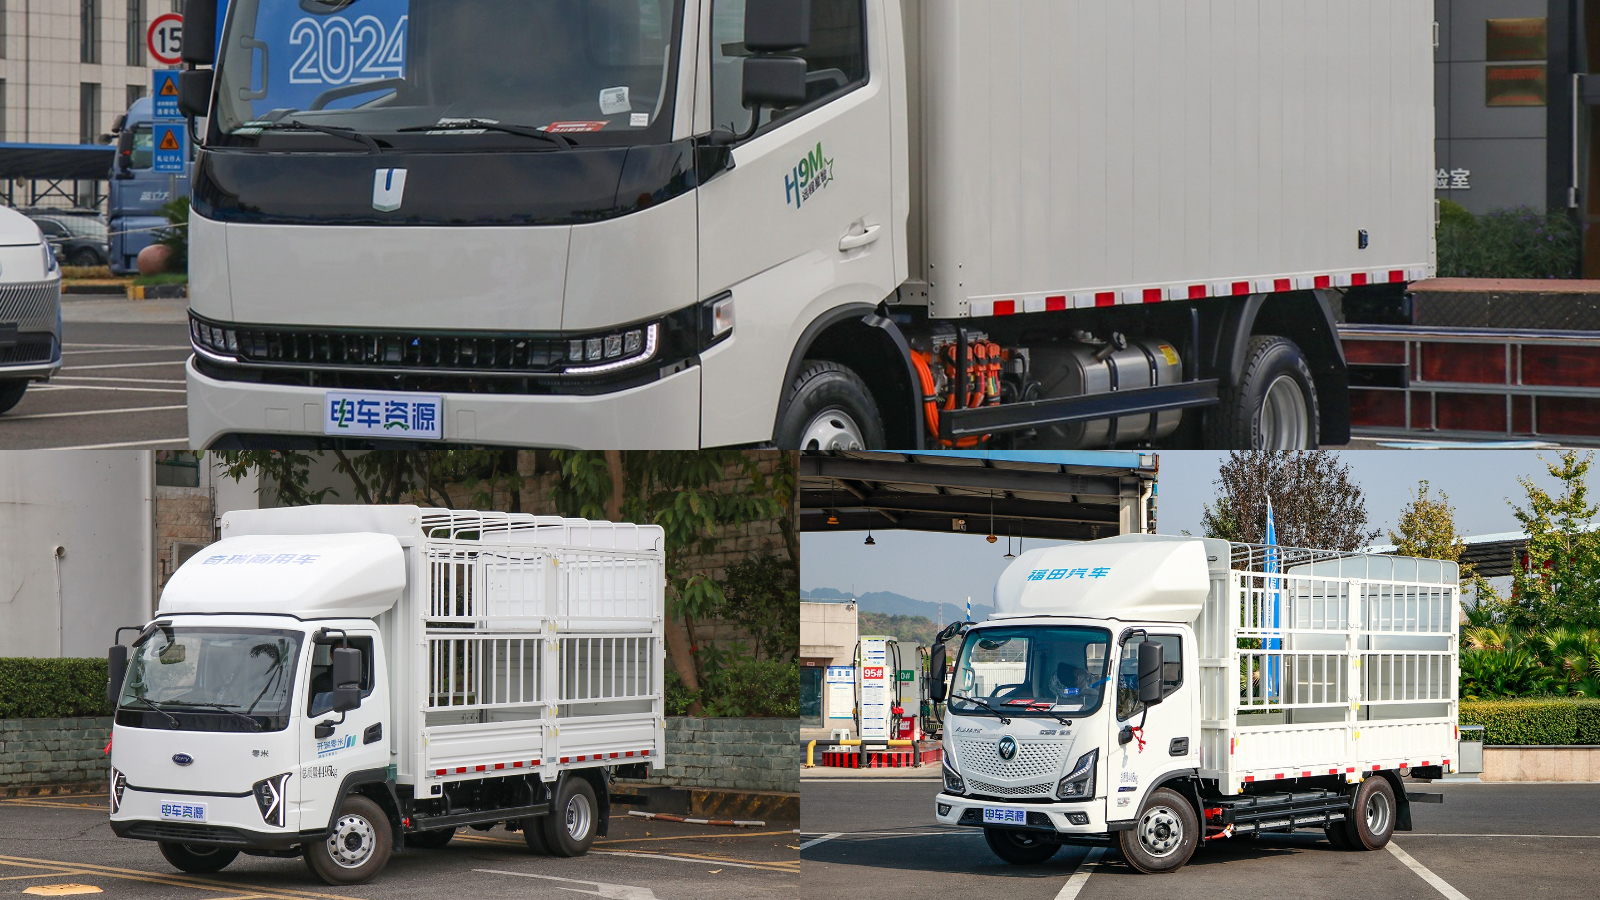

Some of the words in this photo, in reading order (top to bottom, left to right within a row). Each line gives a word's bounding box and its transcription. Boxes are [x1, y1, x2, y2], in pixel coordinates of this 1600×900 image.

[158, 27, 182, 53] 15
[289, 15, 408, 84] 2024
[784, 141, 823, 209] H9M
[331, 398, 436, 431] 电车资源
[202, 553, 321, 566] 奇瑞商用车
[1027, 567, 1111, 581] 福田汽车
[865, 669, 882, 678] 95#
[161, 804, 204, 819] 电车资源
[985, 809, 1024, 822] 电车资源
